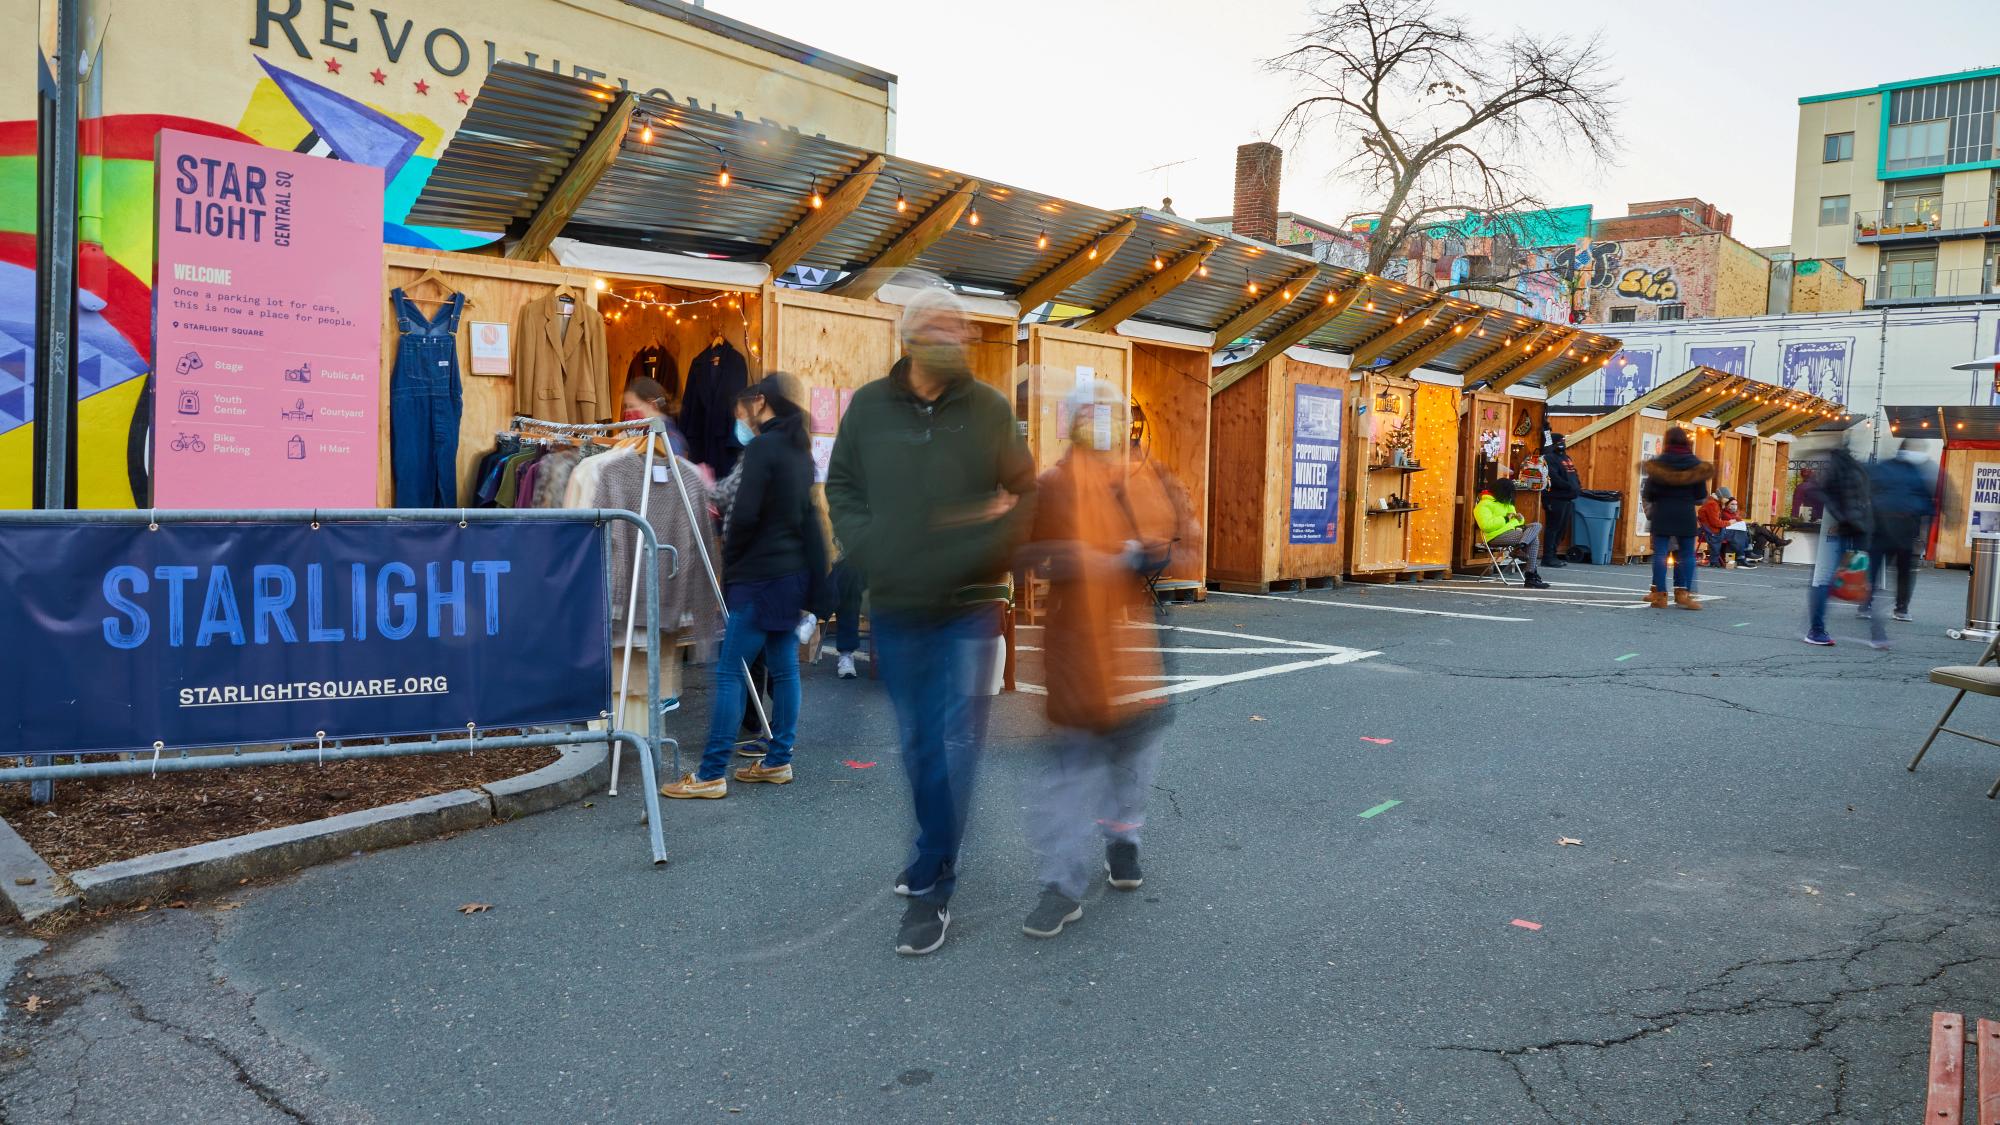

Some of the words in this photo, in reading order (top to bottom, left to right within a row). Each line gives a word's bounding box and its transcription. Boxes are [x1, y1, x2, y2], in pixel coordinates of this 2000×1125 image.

[176, 154, 267, 206] STAR
[276, 170, 294, 188] SQ
[175, 197, 267, 243] LIGHT
[274, 192, 292, 247] CENTRAL
[174, 263, 232, 286] WELCOME
[173, 287, 199, 297] Once
[218, 293, 261, 306] parking
[267, 298, 283, 307] lot
[290, 301, 307, 309] for
[312, 304, 340, 315] cars,
[174, 301, 199, 310] this
[205, 303, 217, 312] is
[260, 310, 289, 320] place
[296, 314, 312, 322] for
[318, 317, 356, 327] people.
[183, 322, 228, 333] STARLIGHT
[231, 327, 264, 337] SQUARE
[214, 361, 244, 373] Stage
[321, 370, 349, 380] Public
[351, 372, 365, 382] Art
[213, 394, 242, 405] Youth
[214, 405, 246, 416] Center
[320, 407, 364, 418] Courtyard
[213, 433, 236, 443] Bike
[213, 444, 251, 456] Parking
[319, 444, 327, 453] H
[329, 444, 350, 454] Mart
[1295, 443, 1339, 462] POPPORTUNITY
[1295, 462, 1327, 485] WINTER
[1293, 487, 1328, 510] MARKET
[1974, 491, 2000, 504] MAR
[101, 560, 511, 649] STARLIGHT
[179, 676, 449, 706] STARLIGHTSQUARE.ORG
